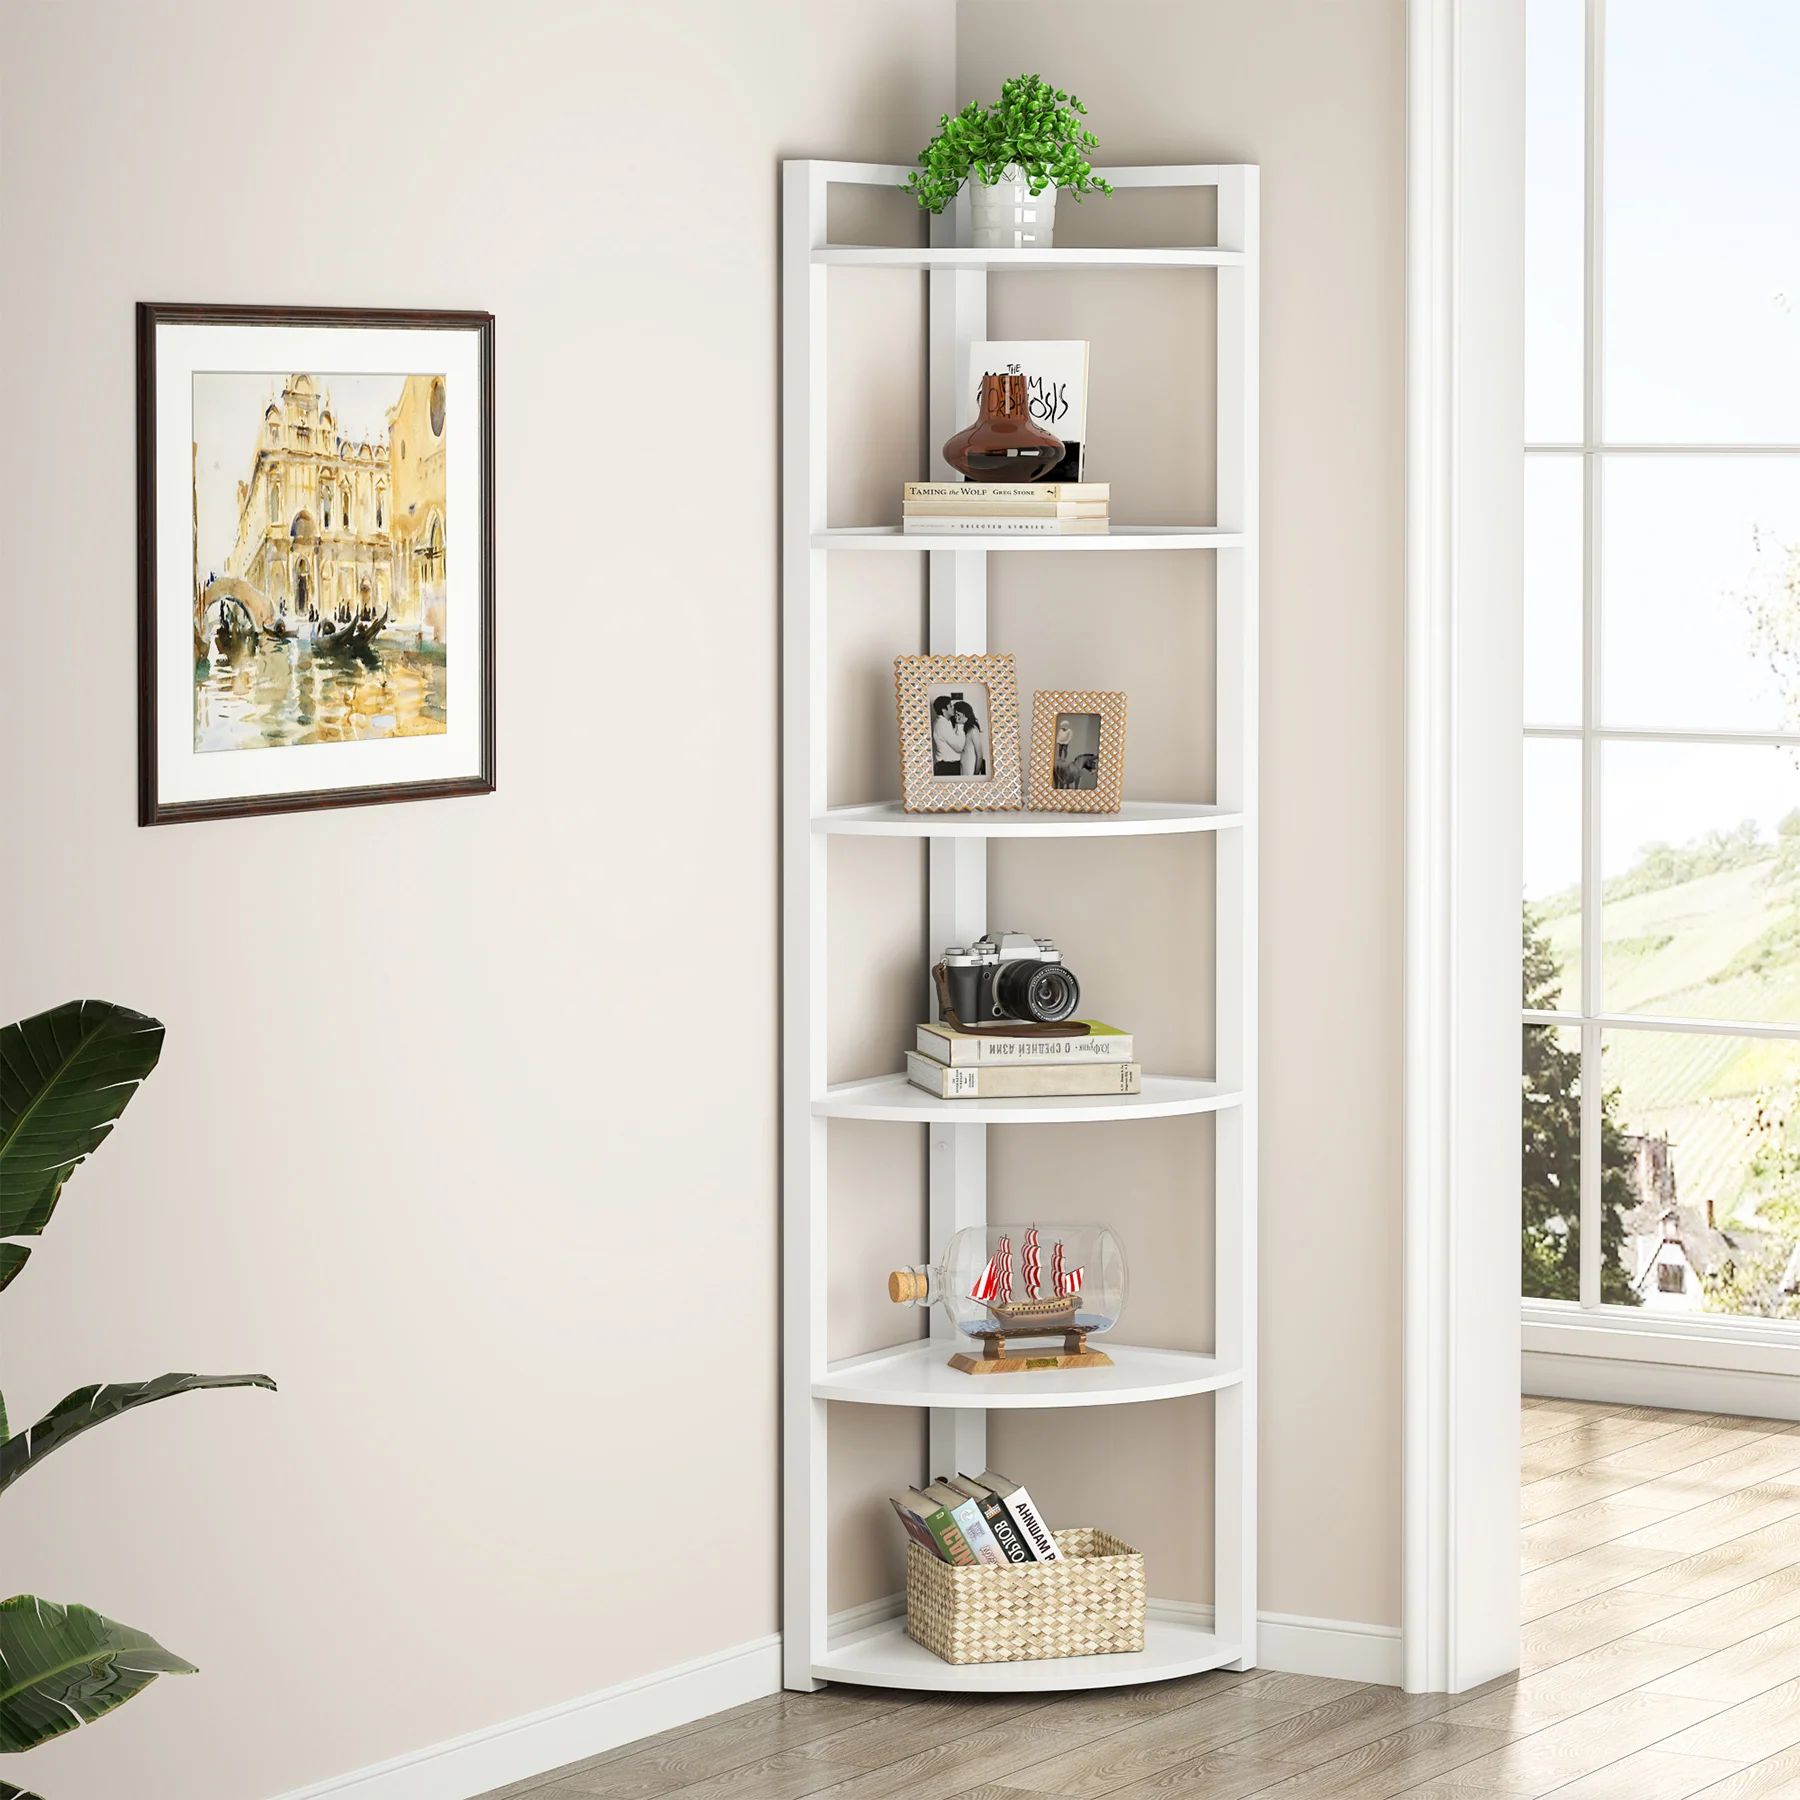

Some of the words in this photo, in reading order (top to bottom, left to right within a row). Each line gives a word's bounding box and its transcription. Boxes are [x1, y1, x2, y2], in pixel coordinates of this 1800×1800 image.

[1007, 364, 1020, 374] THE
[949, 488, 959, 496] the
[989, 1043, 1015, 1055] АЗИИ
[1018, 1042, 1061, 1058] СРЕДНЕЙ
